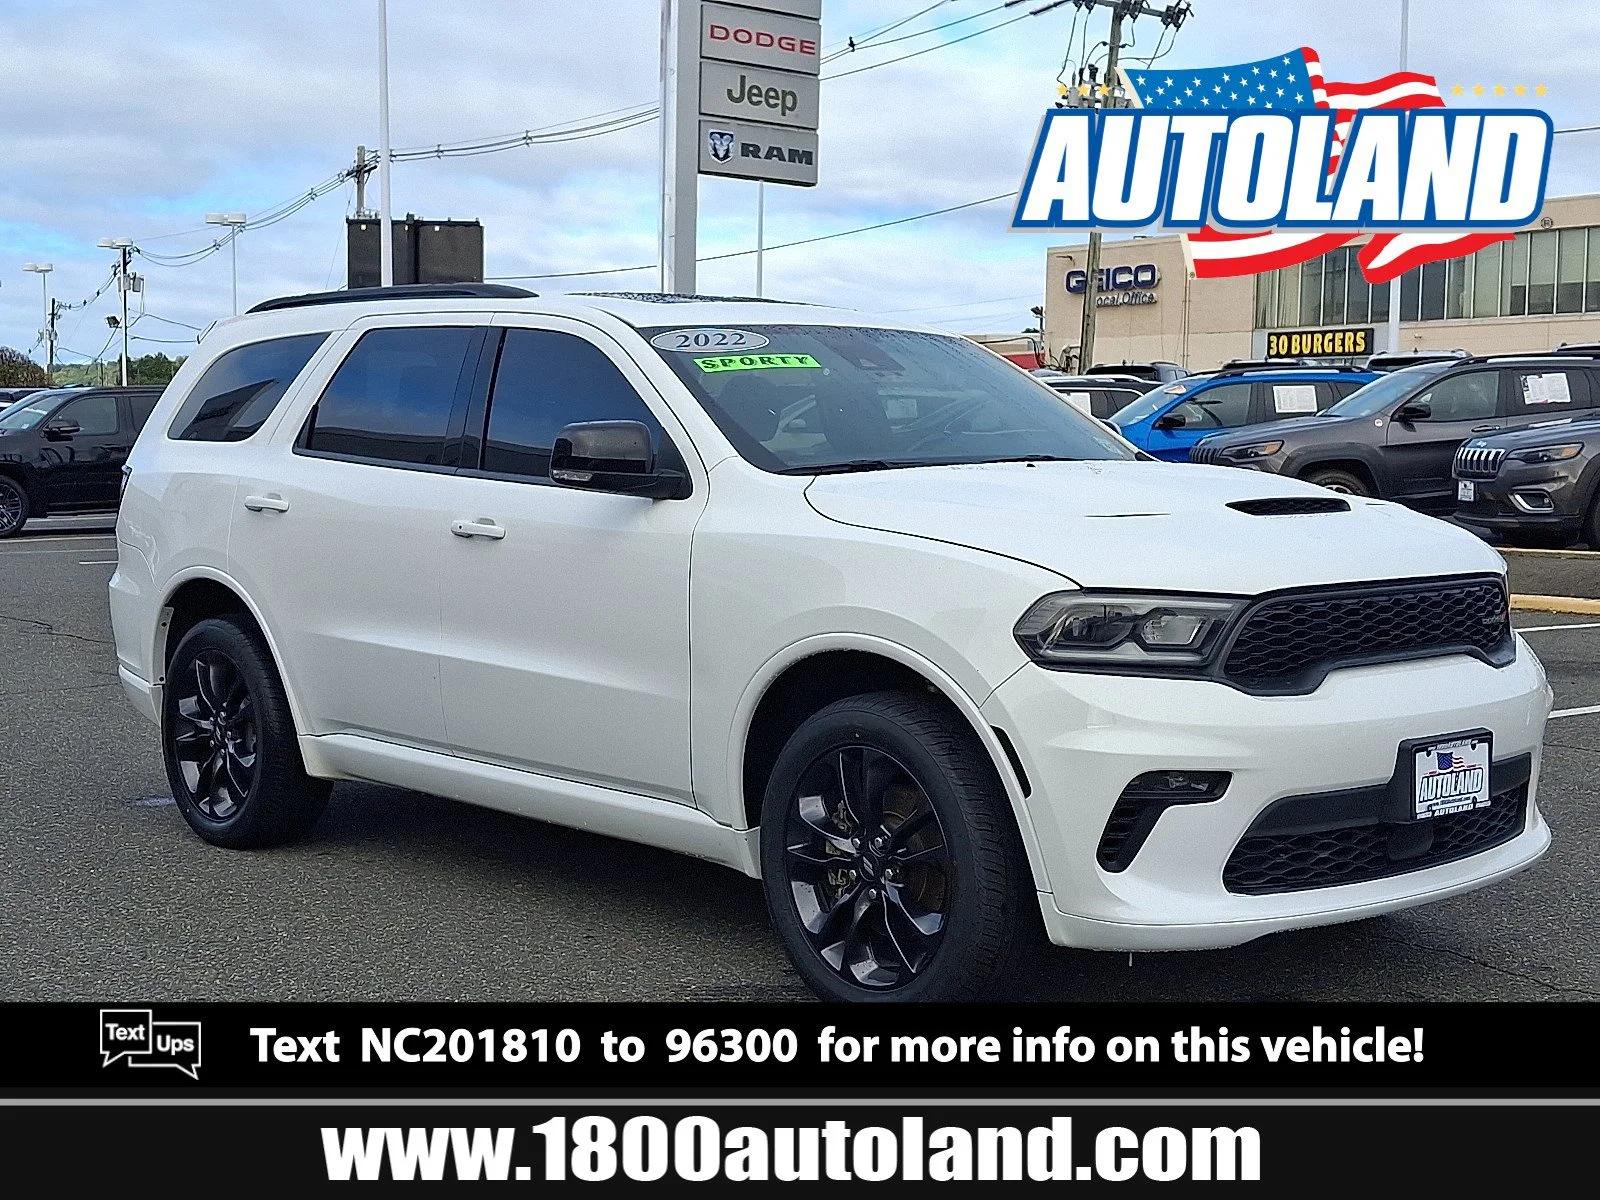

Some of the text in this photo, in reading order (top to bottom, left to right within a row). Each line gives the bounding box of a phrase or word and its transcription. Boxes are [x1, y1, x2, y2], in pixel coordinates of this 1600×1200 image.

[709, 24, 816, 56] DODGE
[726, 74, 798, 117] Jeep
[740, 142, 813, 166] RAM
[1096, 292, 1120, 306] ocal
[675, 332, 747, 348] 2022
[1269, 331, 1366, 356] 30 BURGERS
[701, 355, 809, 370] SPORTY
[1419, 769, 1483, 803] AUTOLAND
[1434, 803, 1474, 817] AUTOLAND
